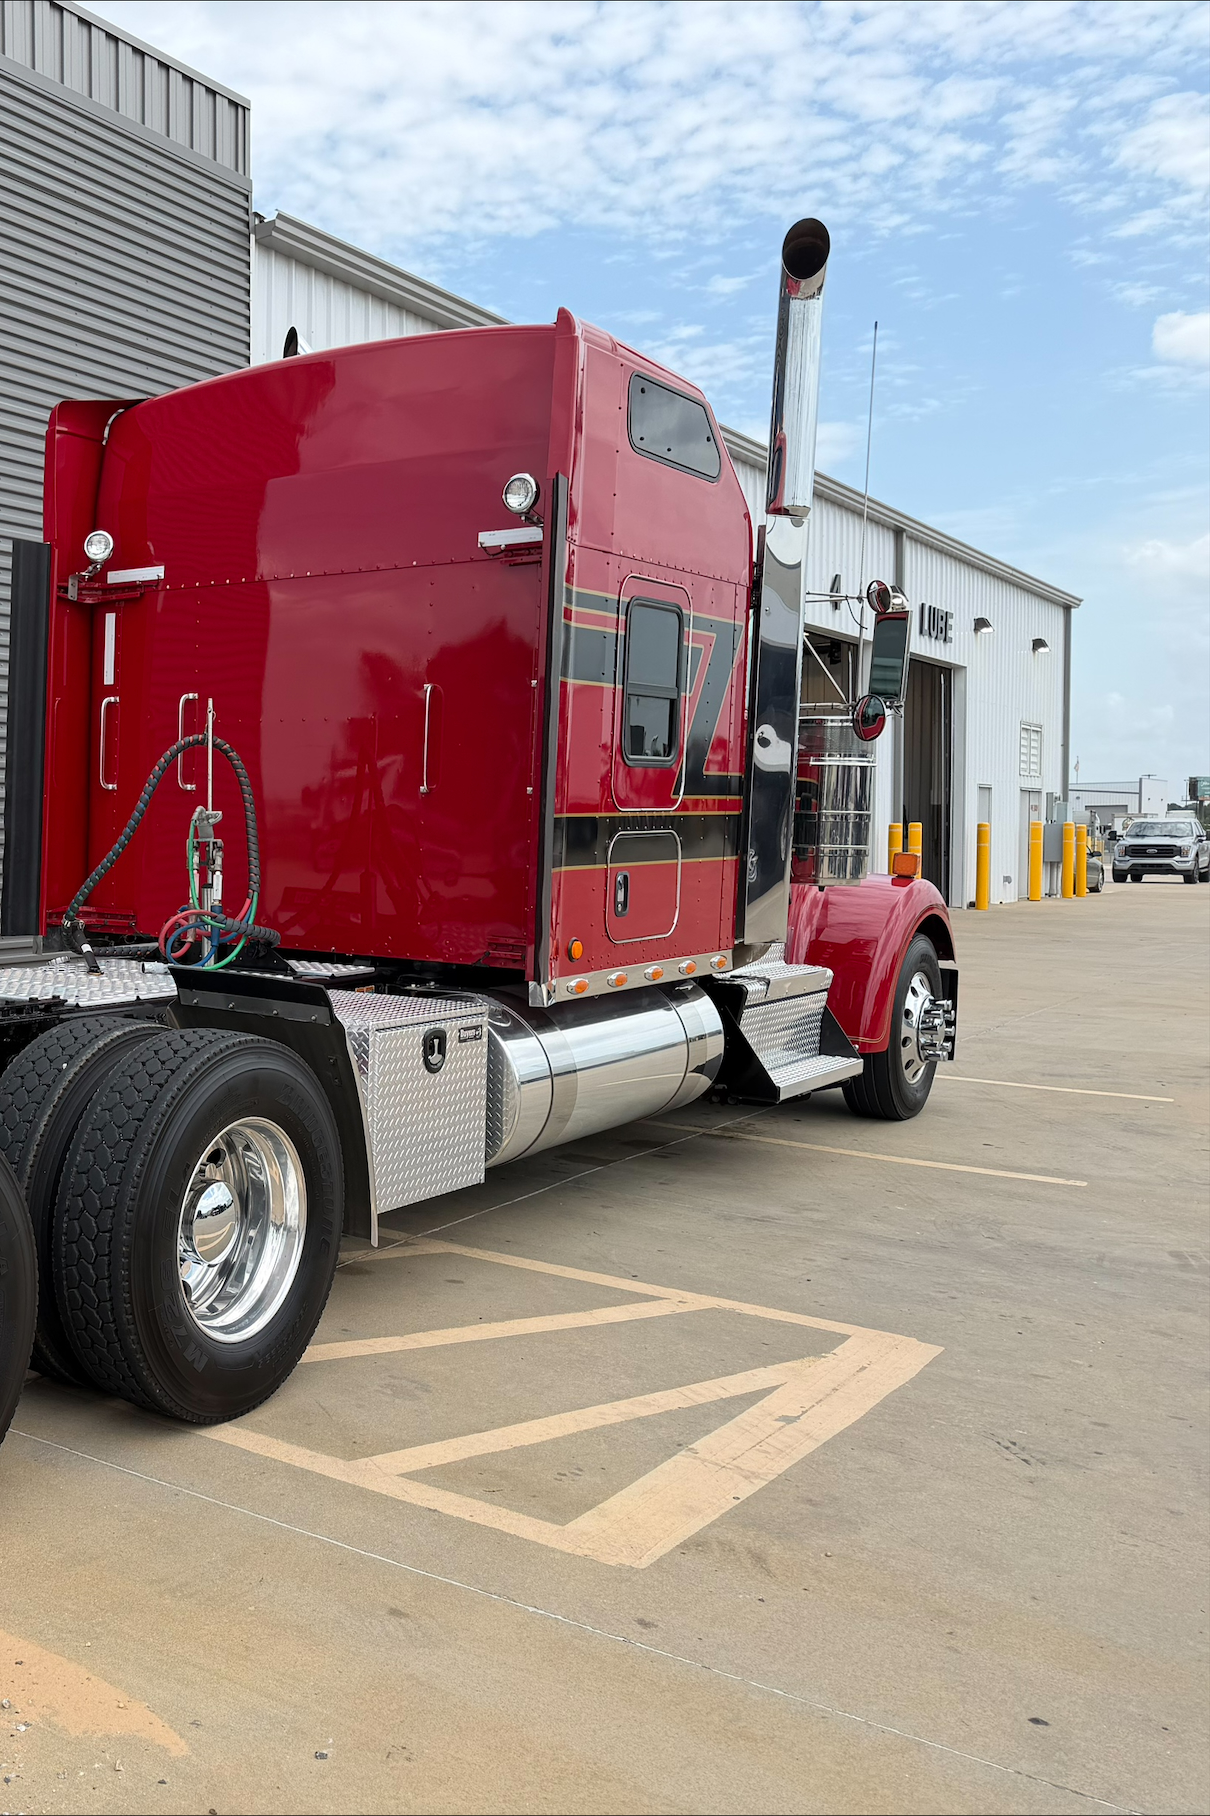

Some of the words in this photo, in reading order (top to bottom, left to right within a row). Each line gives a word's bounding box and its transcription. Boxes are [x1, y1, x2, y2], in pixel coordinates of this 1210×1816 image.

[829, 573, 842, 611] 4
[919, 602, 954, 644] LUBE
[274, 1082, 336, 1256] BRIDGESTONE
